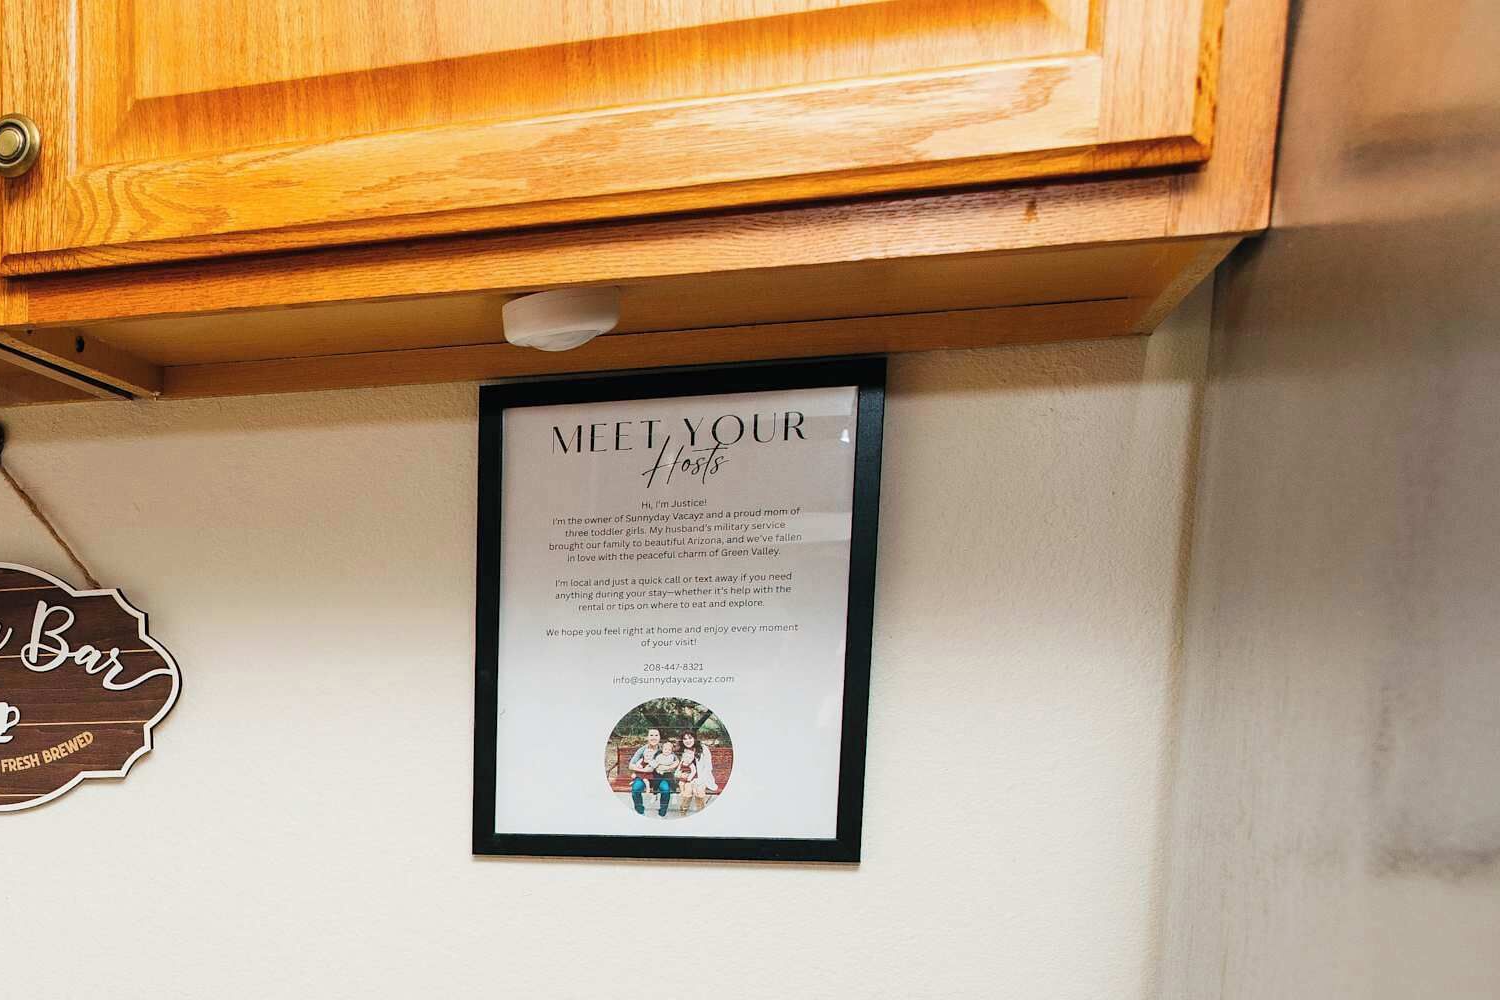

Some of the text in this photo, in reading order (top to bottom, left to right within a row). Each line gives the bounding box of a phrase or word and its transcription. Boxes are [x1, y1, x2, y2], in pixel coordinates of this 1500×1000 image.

[552, 411, 809, 454] MEET YOUR
[641, 435, 730, 488] Hosts
[641, 499, 707, 510] Hi, I'm Justice!
[553, 517, 565, 525] I'm
[614, 514, 624, 523] of
[626, 513, 670, 523] Sunnyday
[672, 512, 703, 521] Vacayz
[706, 510, 723, 518] and
[733, 509, 761, 519] proud
[764, 508, 788, 516] mom
[790, 507, 800, 515] of
[591, 528, 623, 536] toddler
[626, 526, 646, 536] girls.
[649, 526, 662, 535] My
[665, 524, 712, 533] husband's
[714, 522, 749, 532] military
[751, 521, 786, 530] service
[549, 542, 583, 551] brought
[603, 540, 630, 550] family
[644, 538, 685, 547] beautiful
[688, 537, 725, 546] Arizona,
[727, 535, 744, 543] and
[746, 534, 774, 543] we've
[775, 533, 802, 542] fallen
[568, 547, 780, 562] in love with the peaceful charm of Green Valley.
[555, 579, 568, 587] I'm
[570, 578, 591, 587] local
[593, 578, 610, 586] and
[611, 578, 629, 587] just
[638, 576, 662, 586] quick
[664, 576, 680, 584] call
[714, 575, 738, 584] away
[741, 573, 747, 581] if
[749, 574, 766, 582] you
[768, 572, 792, 580] need
[556, 591, 593, 601] anything
[595, 590, 623, 599] during
[626, 591, 646, 599] your
[714, 587, 728, 595] it's
[730, 586, 751, 595] help
[753, 585, 773, 594] with
[775, 585, 792, 593] the
[579, 603, 604, 611] rental
[618, 602, 635, 611] tips
[636, 602, 649, 610] on
[650, 601, 678, 609] where
[708, 600, 726, 608] and
[728, 599, 765, 609] explore.
[546, 624, 799, 637] We hope you feel right at home and enjoy every moment
[21, 600, 173, 690] Bar
[641, 638, 697, 648] of your visit!
[1, 753, 41, 773] FRESH
[42, 731, 94, 763] BREWED
